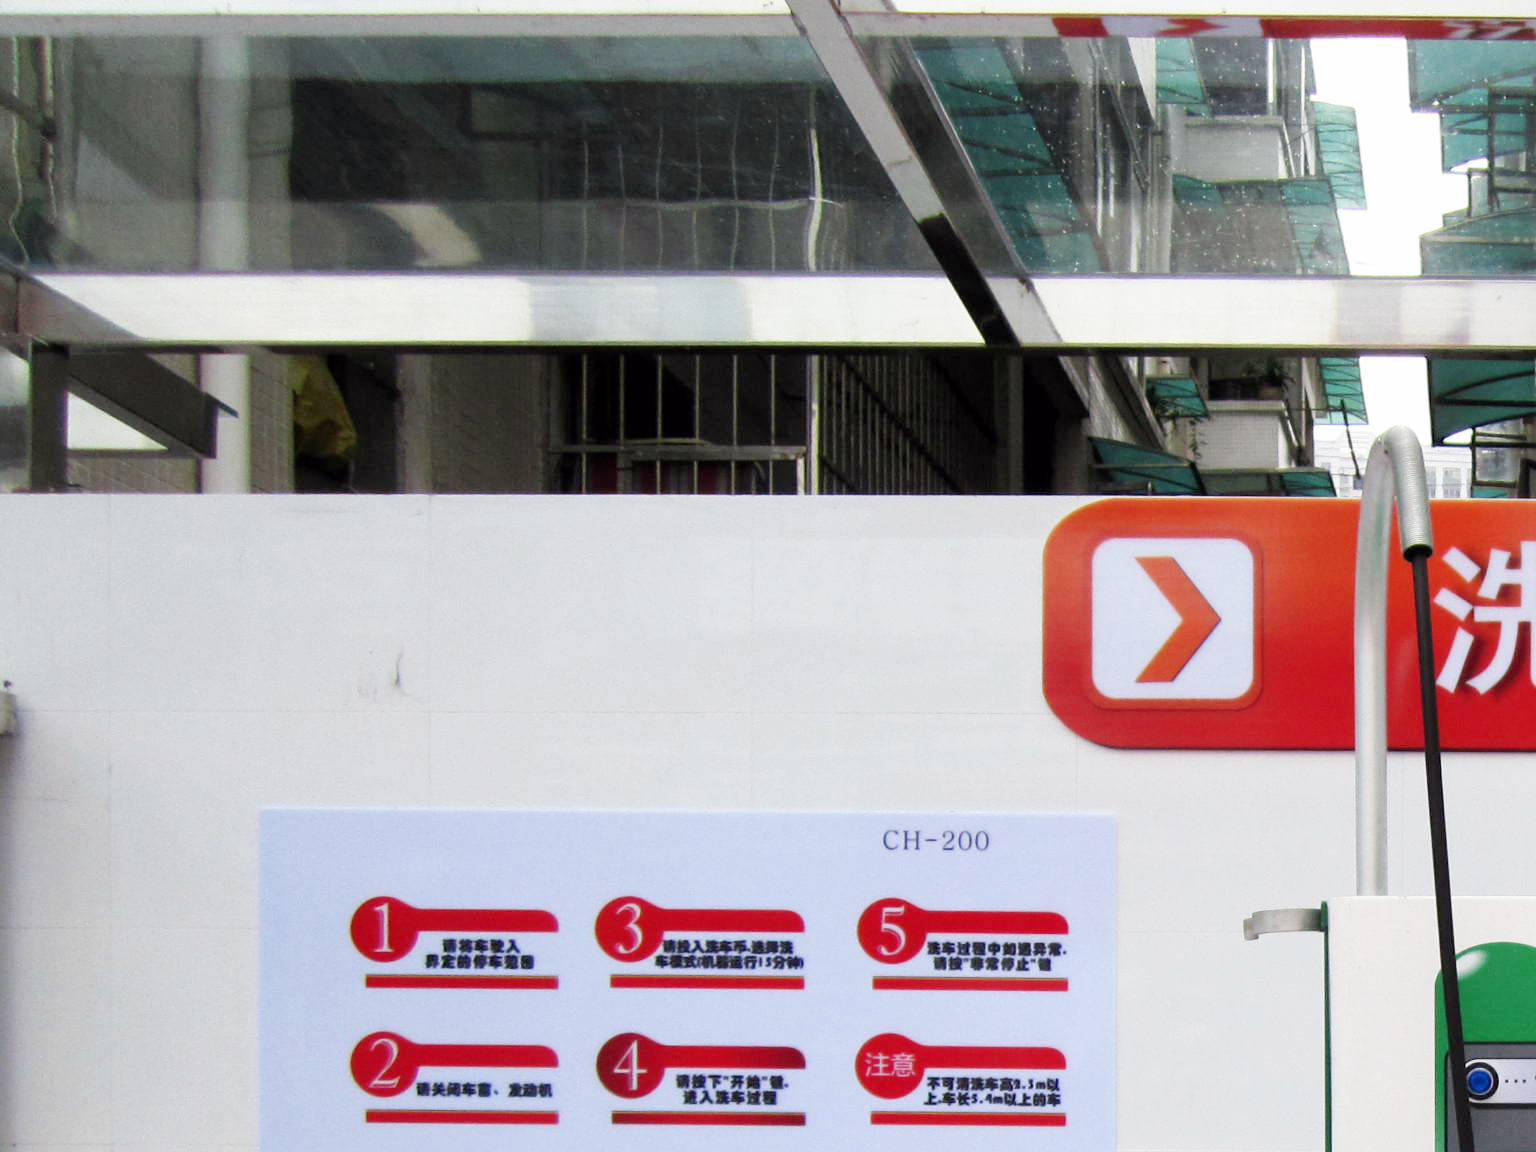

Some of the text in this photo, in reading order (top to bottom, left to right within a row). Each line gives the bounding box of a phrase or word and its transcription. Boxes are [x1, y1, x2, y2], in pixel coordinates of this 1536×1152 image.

[882, 829, 990, 851] CH-200
[373, 902, 395, 953] 1
[615, 902, 644, 954] 3
[876, 905, 907, 956] 5
[367, 1037, 401, 1089] 2
[613, 1039, 648, 1091] 4
[864, 1052, 917, 1078] 注意
